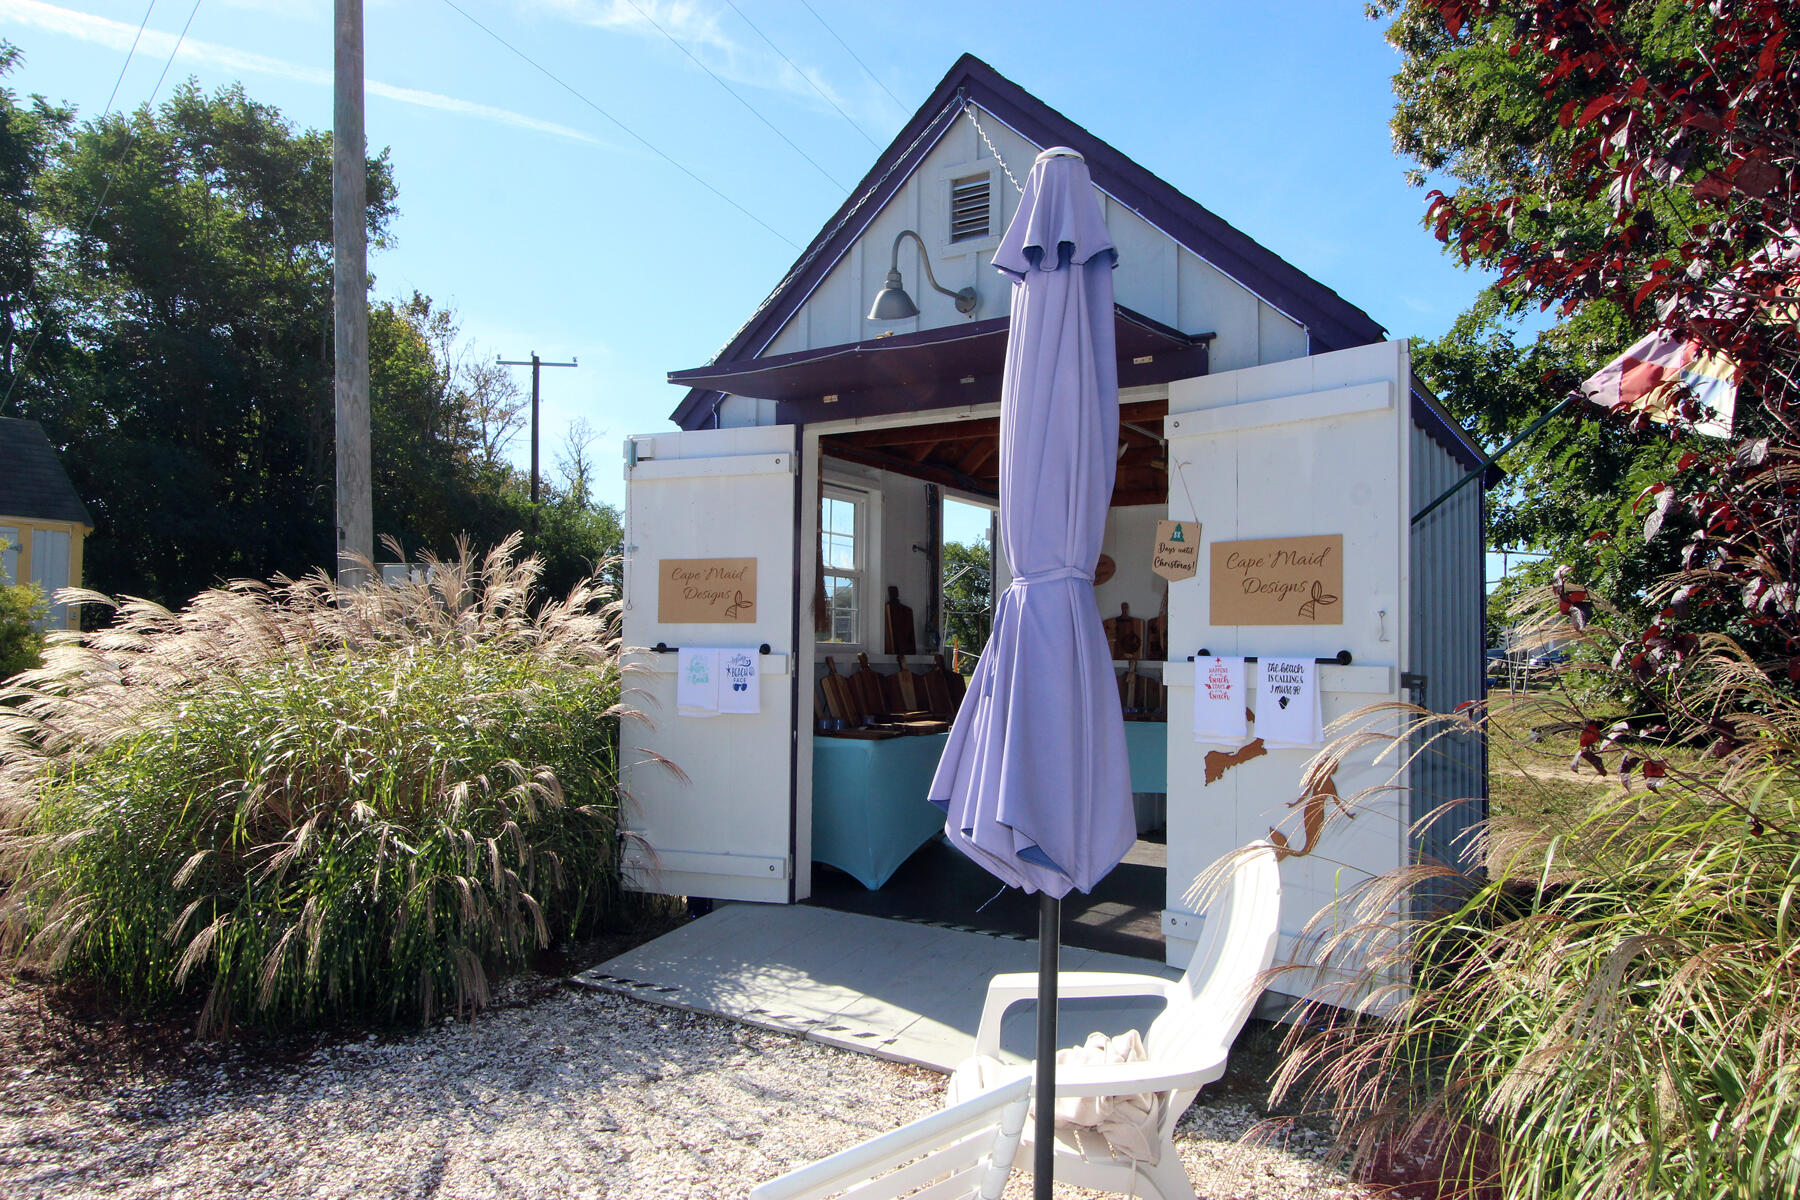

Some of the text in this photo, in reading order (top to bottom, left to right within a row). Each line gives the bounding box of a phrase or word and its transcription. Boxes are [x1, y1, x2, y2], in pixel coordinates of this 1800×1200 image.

[1158, 542, 1176, 554] Days
[1154, 556, 1196, 572] Christmas!
[1226, 547, 1331, 576] Cape Maid
[671, 566, 748, 585] Cape Maid
[683, 586, 731, 605] Designs
[1242, 577, 1308, 602] Designs
